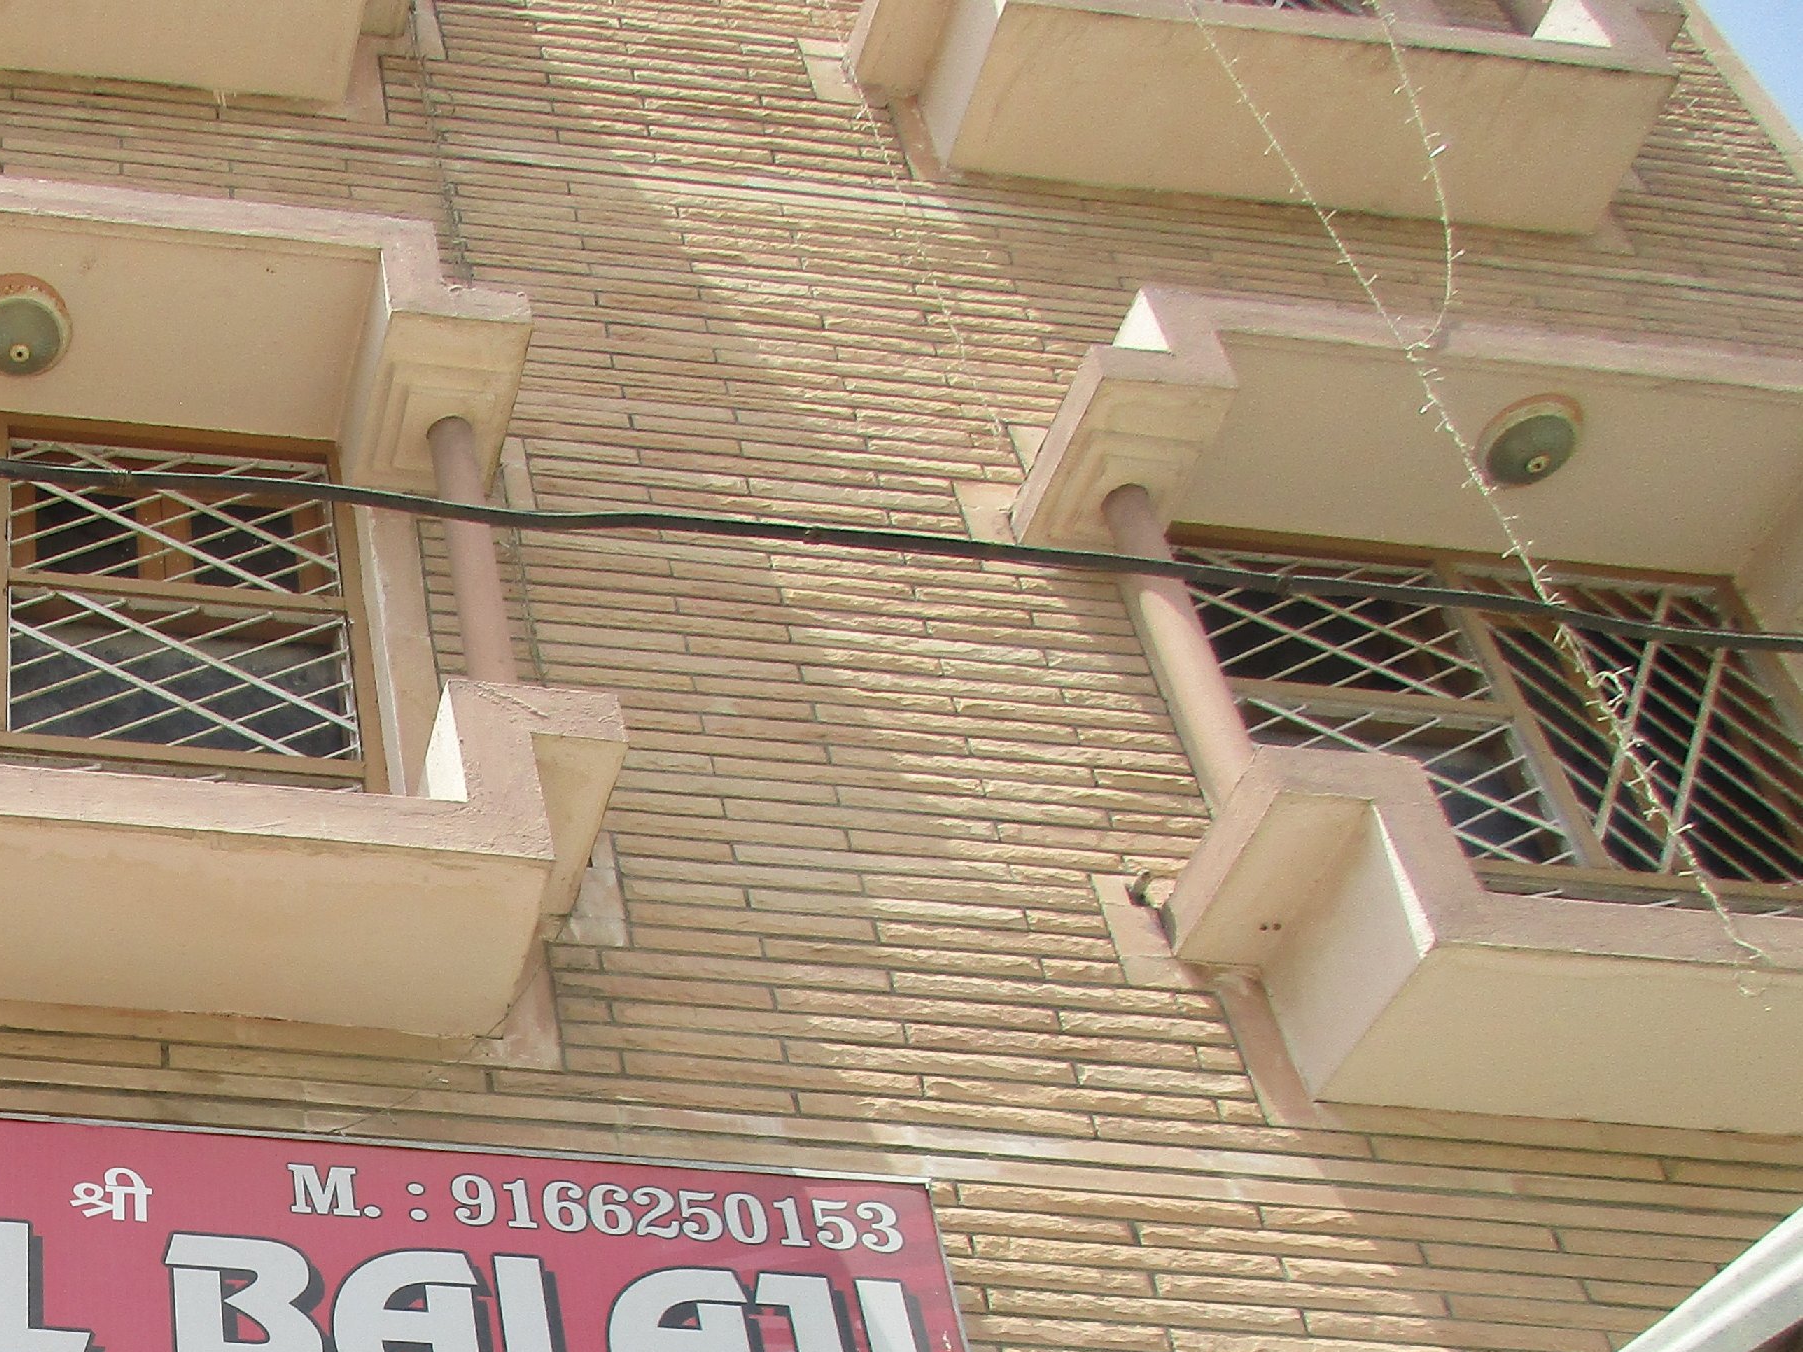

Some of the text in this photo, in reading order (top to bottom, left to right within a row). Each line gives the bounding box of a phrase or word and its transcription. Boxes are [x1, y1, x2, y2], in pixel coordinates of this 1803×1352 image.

[69, 1167, 153, 1223] श्री
[287, 1162, 383, 1219] M.
[449, 1174, 906, 1255] 9166250153
